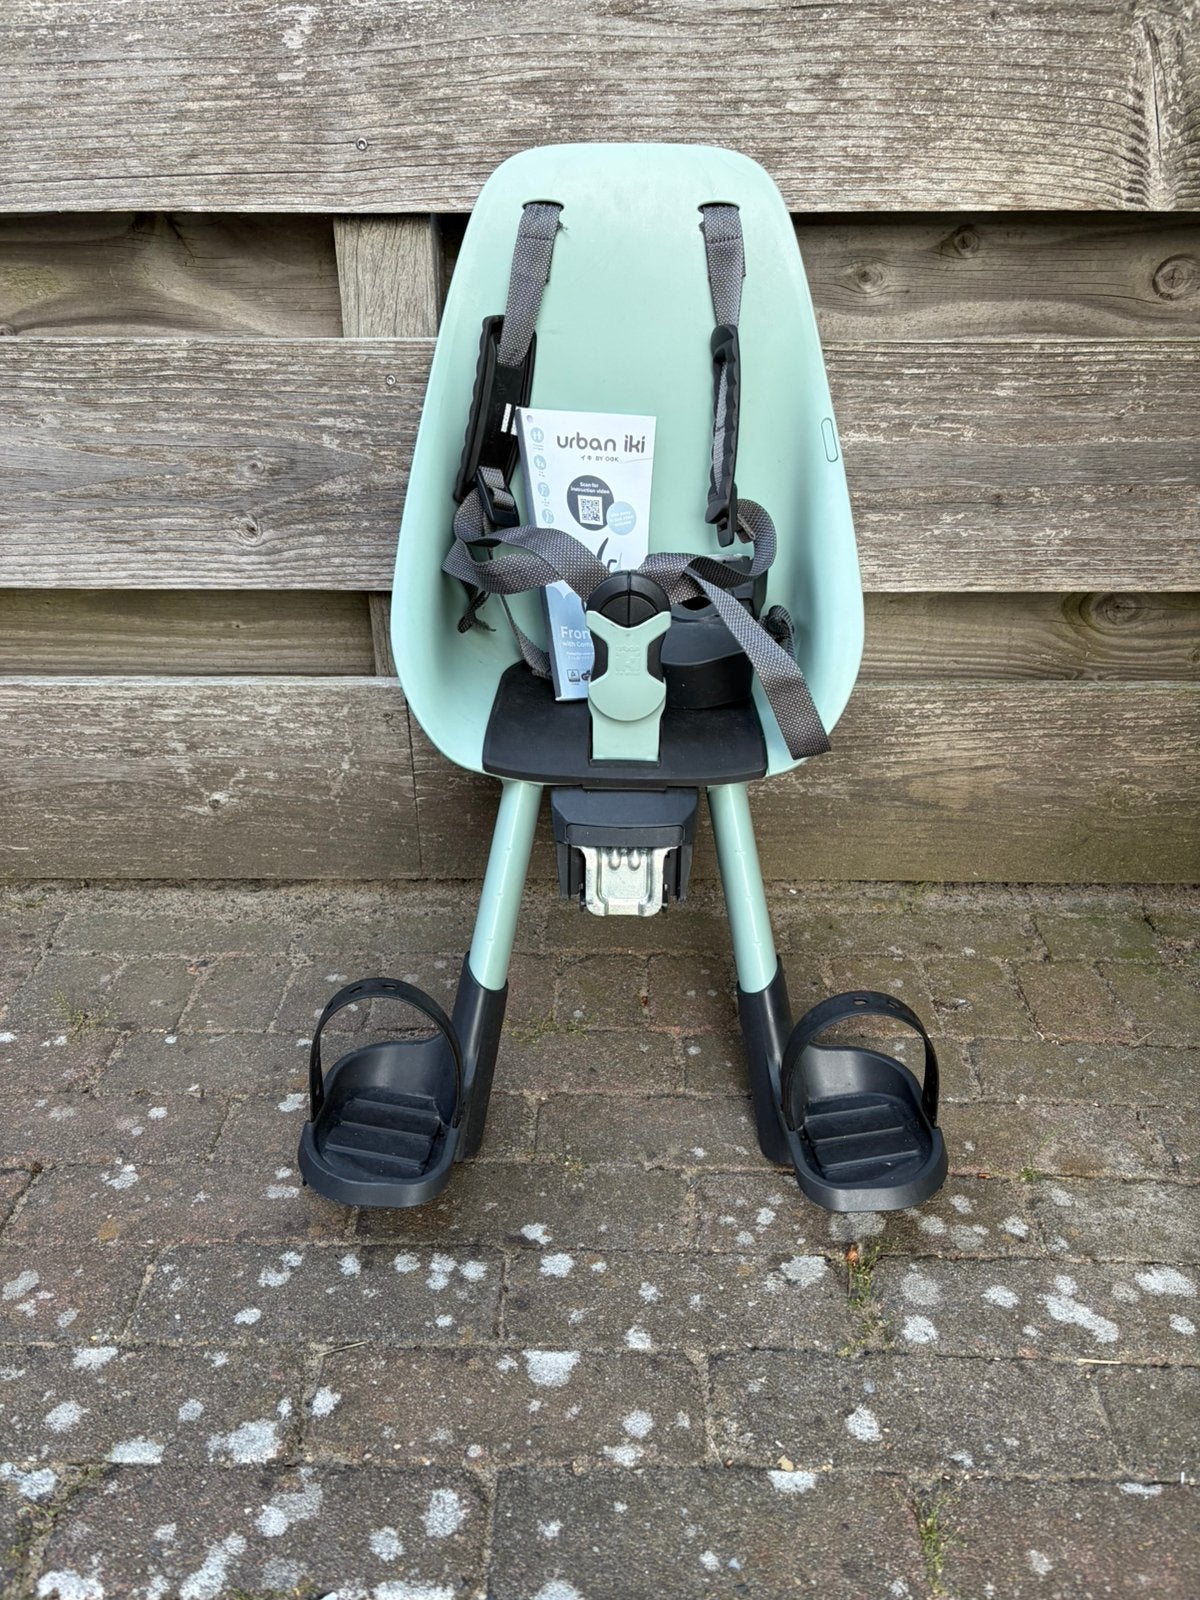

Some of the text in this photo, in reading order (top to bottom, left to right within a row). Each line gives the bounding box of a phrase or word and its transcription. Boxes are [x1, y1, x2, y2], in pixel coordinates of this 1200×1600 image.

[557, 432, 646, 454] urban iki
[570, 485, 596, 494] instruction
